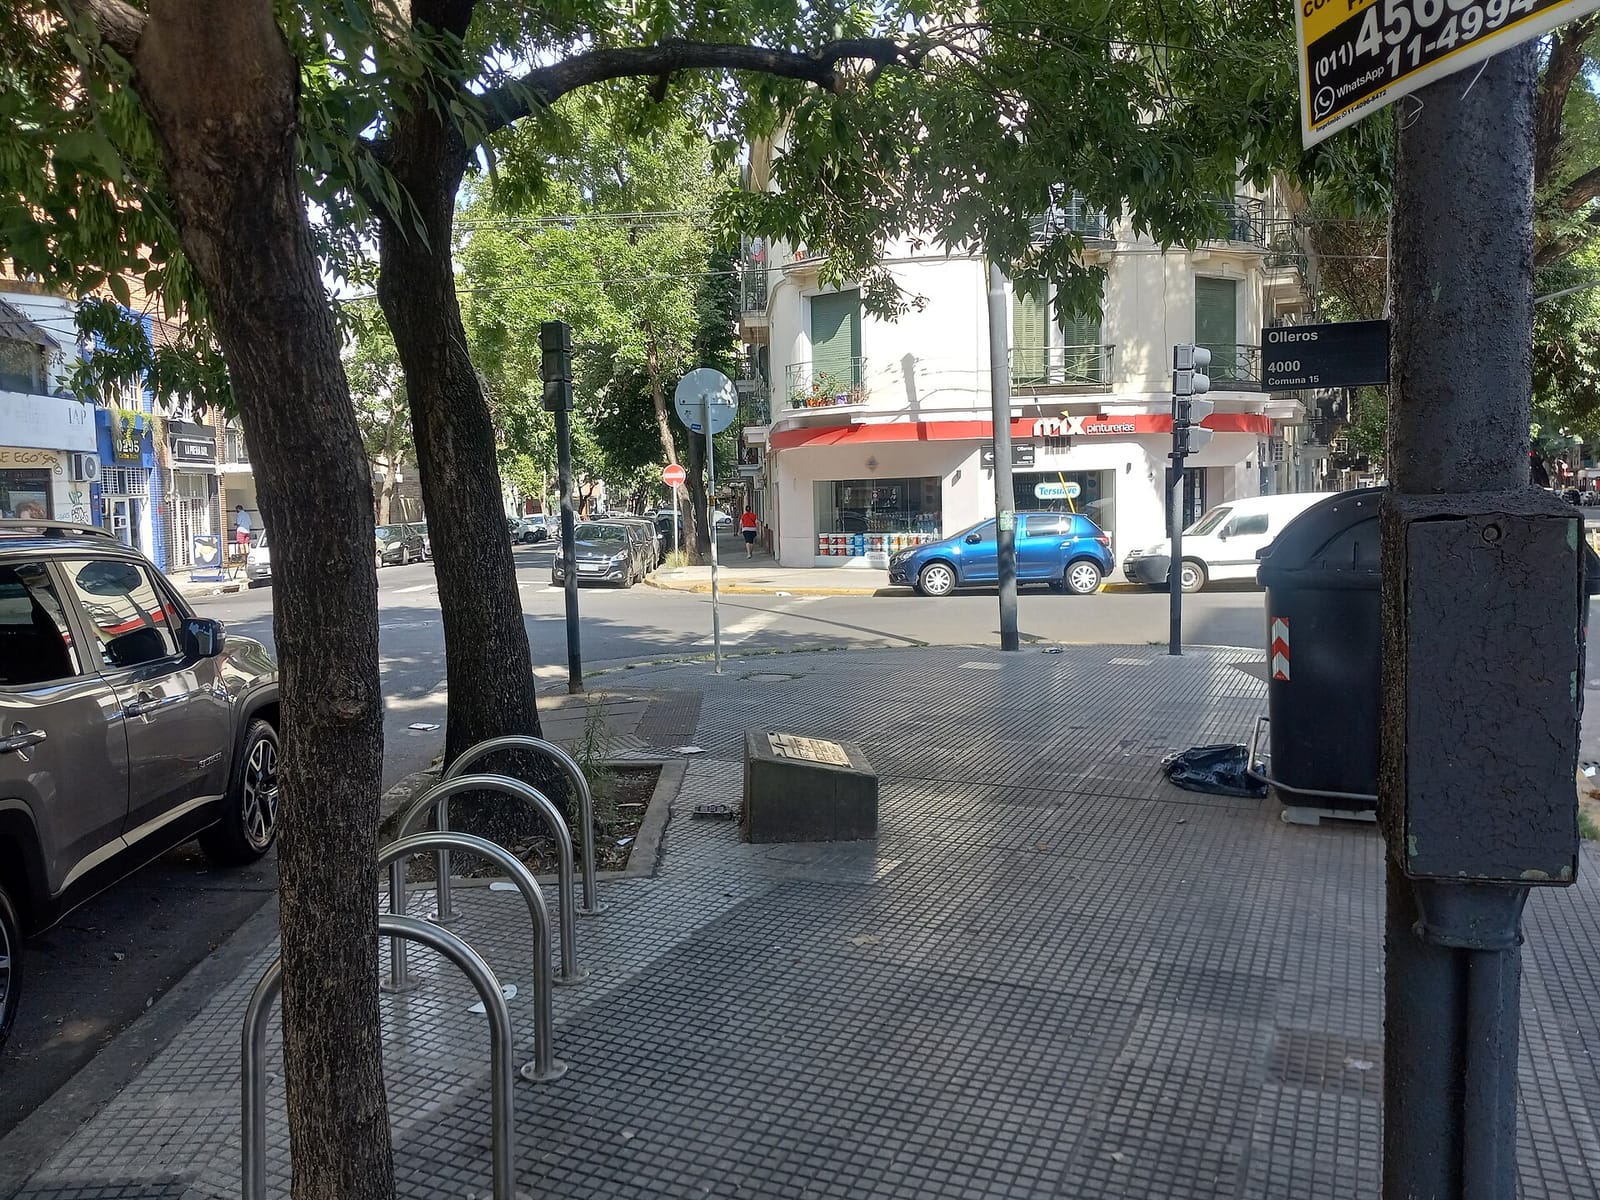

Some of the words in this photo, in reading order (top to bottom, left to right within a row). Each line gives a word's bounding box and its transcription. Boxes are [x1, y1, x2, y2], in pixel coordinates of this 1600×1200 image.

[1303, 0, 1330, 17] CO
[1315, 41, 1354, 85] (011)
[1336, 66, 1385, 99] WhatsApp
[1268, 331, 1319, 343] Olleros
[1267, 360, 1301, 373] 4000
[1268, 377, 1306, 386] Comuna
[1309, 375, 1320, 384] 15
[1039, 486, 1077, 496] Tersuve
